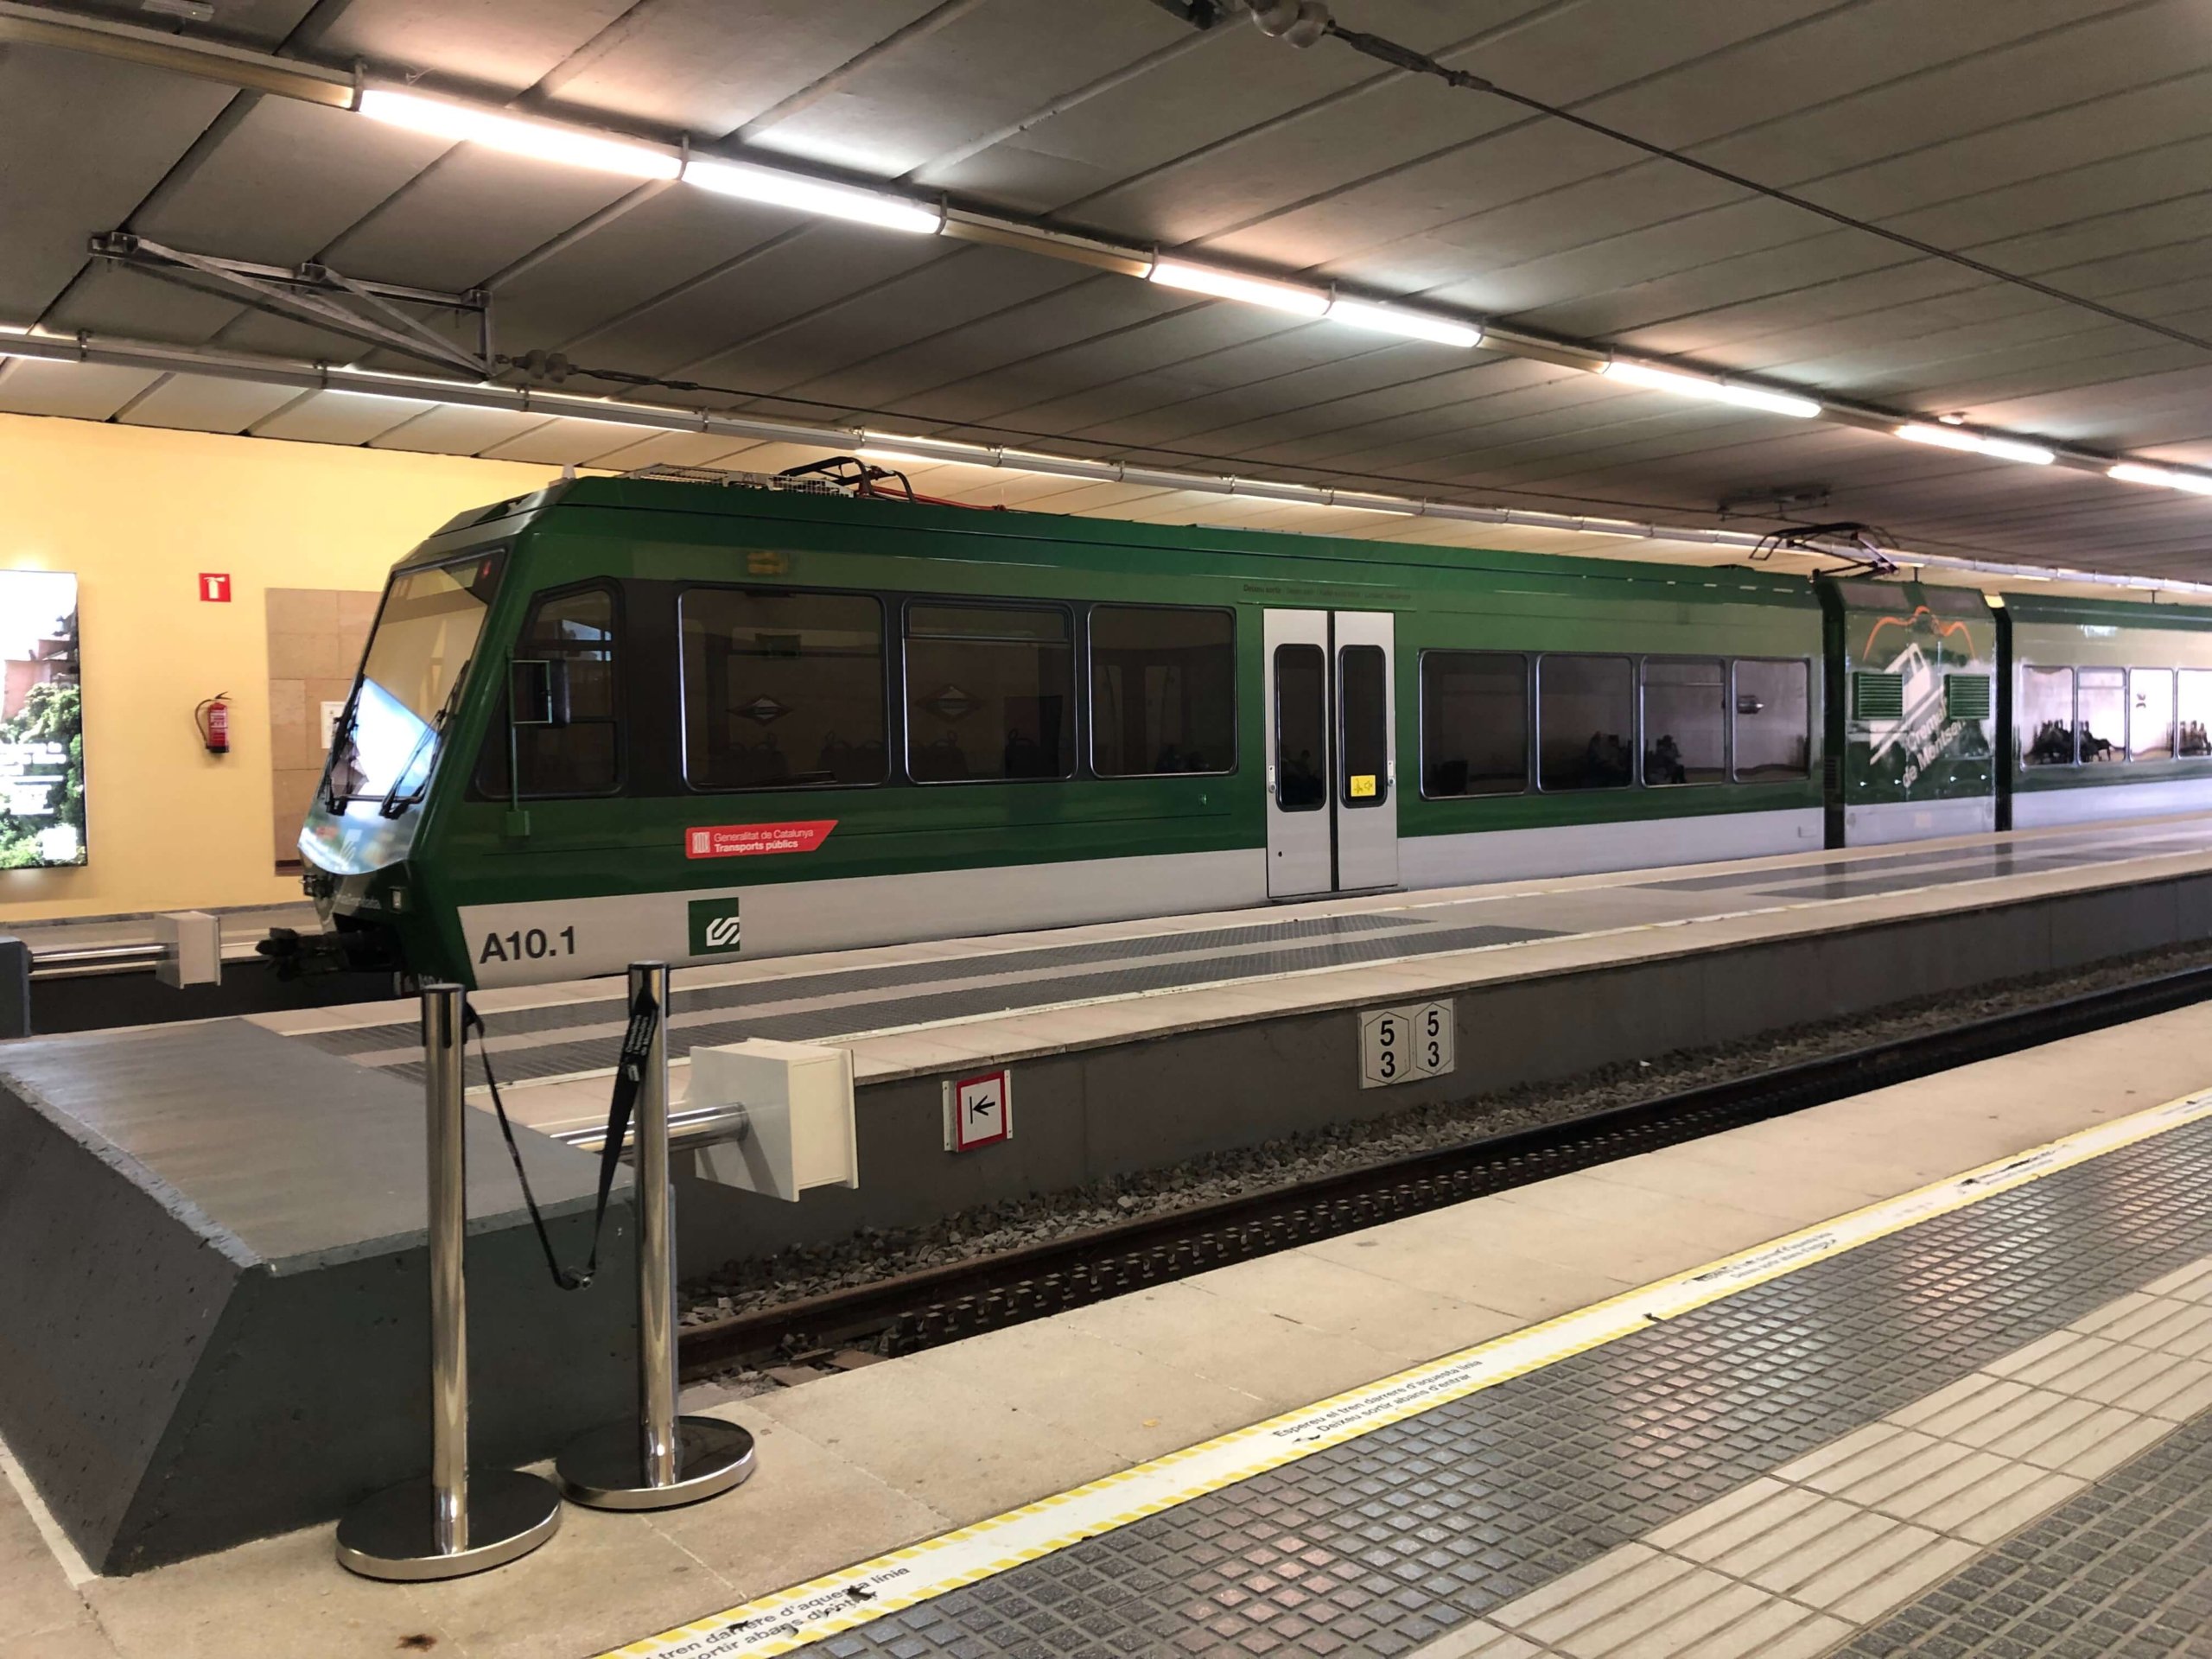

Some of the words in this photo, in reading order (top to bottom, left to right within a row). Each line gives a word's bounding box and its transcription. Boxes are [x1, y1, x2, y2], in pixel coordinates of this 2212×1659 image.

[1903, 765, 1917, 788] de
[1917, 719, 1967, 772] Montser
[715, 832, 759, 842] Generalitat
[760, 830, 772, 840] de
[773, 829, 814, 840] Catalunya
[715, 842, 765, 853] Transports
[766, 839, 798, 851] públics
[479, 925, 575, 964] A10.1
[1380, 1020, 1395, 1046] 5
[1427, 1010, 1440, 1037] 5
[1381, 1051, 1395, 1078] 3
[1427, 1041, 1440, 1067] 3
[1273, 1417, 1326, 1437] Espereu
[1337, 1402, 1365, 1413] tren
[1364, 1388, 1407, 1404] darrere
[1317, 1414, 1362, 1432] Deixeu
[1361, 1402, 1393, 1415] sortir
[1394, 1389, 1430, 1404] abans
[658, 1642, 702, 1659] tren
[780, 1581, 870, 1618] d'aquesa
[689, 1642, 740, 1659] ortir
